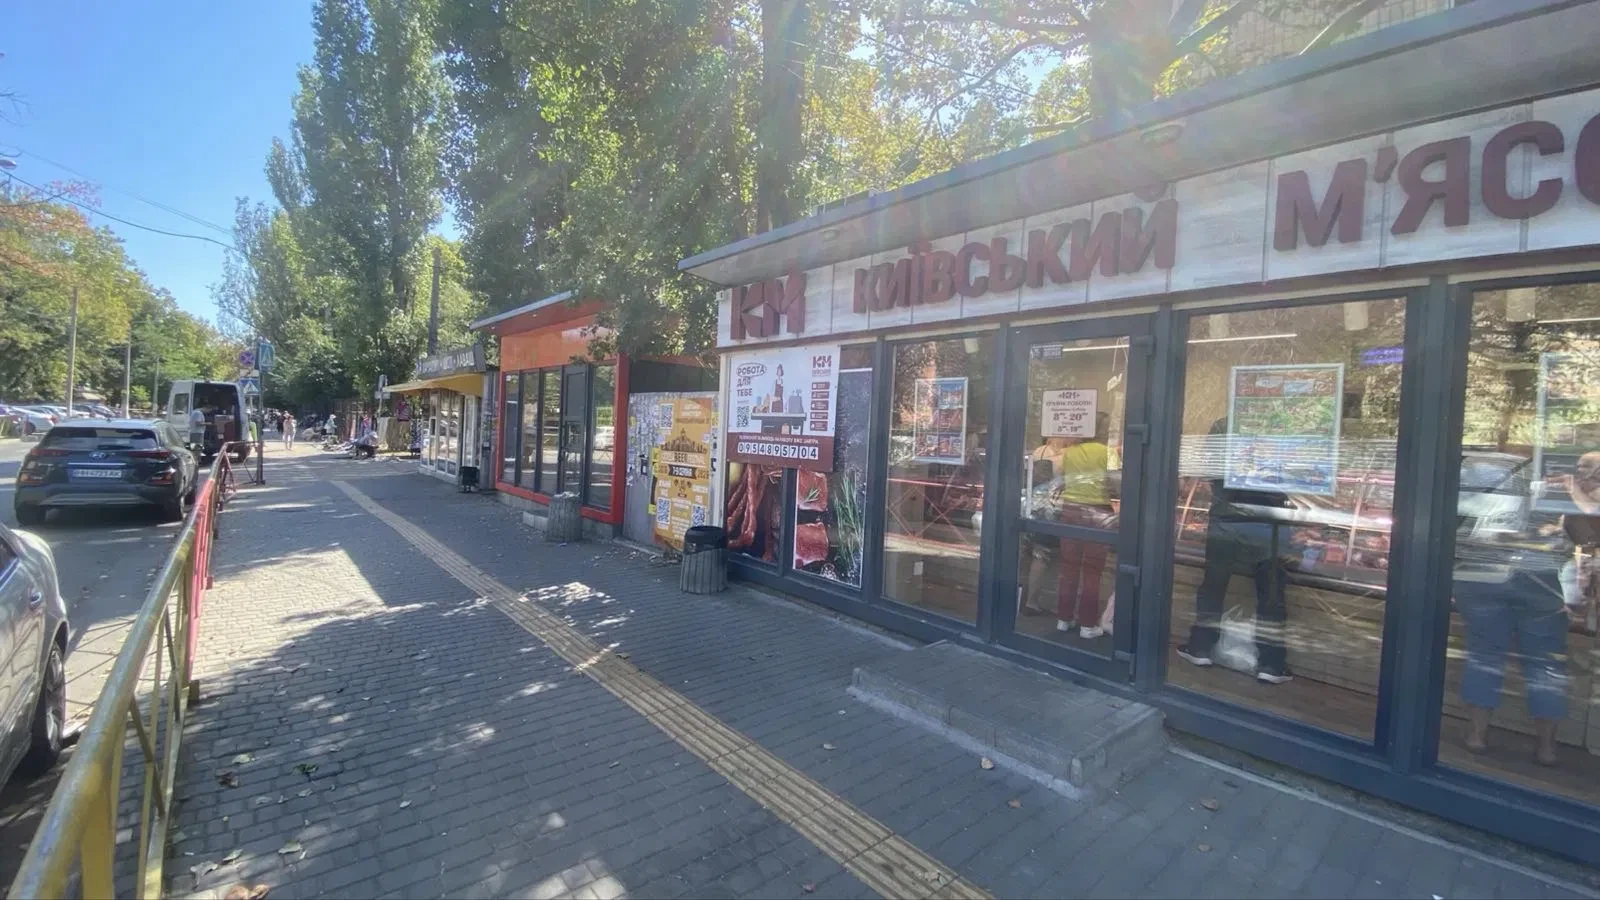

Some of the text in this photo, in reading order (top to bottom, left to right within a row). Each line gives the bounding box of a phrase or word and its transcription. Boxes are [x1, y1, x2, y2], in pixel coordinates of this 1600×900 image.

[730, 271, 807, 340] КМ
[853, 184, 1178, 314] КИЇВСЬКИЙ
[813, 355, 832, 369] КМ
[737, 364, 766, 376] РОБОТА
[737, 378, 751, 387] ДЛЯ
[737, 388, 753, 397] ТЕБЕ
[738, 442, 818, 460] 0954895704
